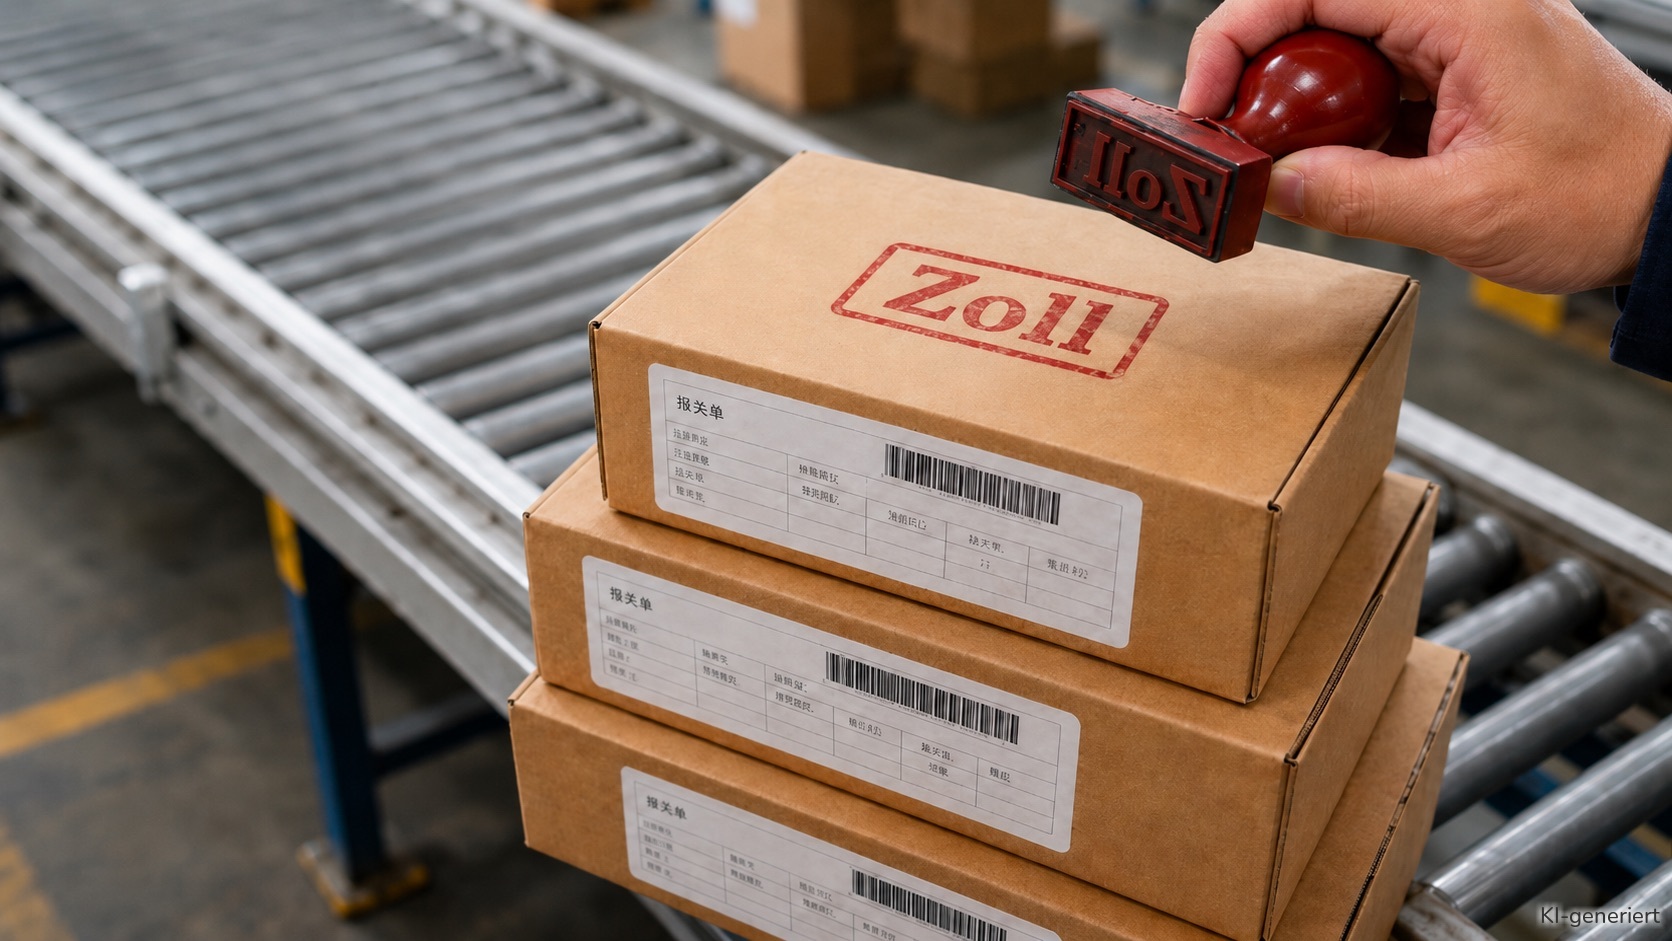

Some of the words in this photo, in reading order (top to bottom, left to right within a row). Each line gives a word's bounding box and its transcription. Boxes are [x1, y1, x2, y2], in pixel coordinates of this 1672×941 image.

[882, 264, 1114, 356] Zoll
[676, 394, 725, 421] 报关单
[609, 586, 654, 612] 报关单
[646, 794, 688, 821] 报关单
